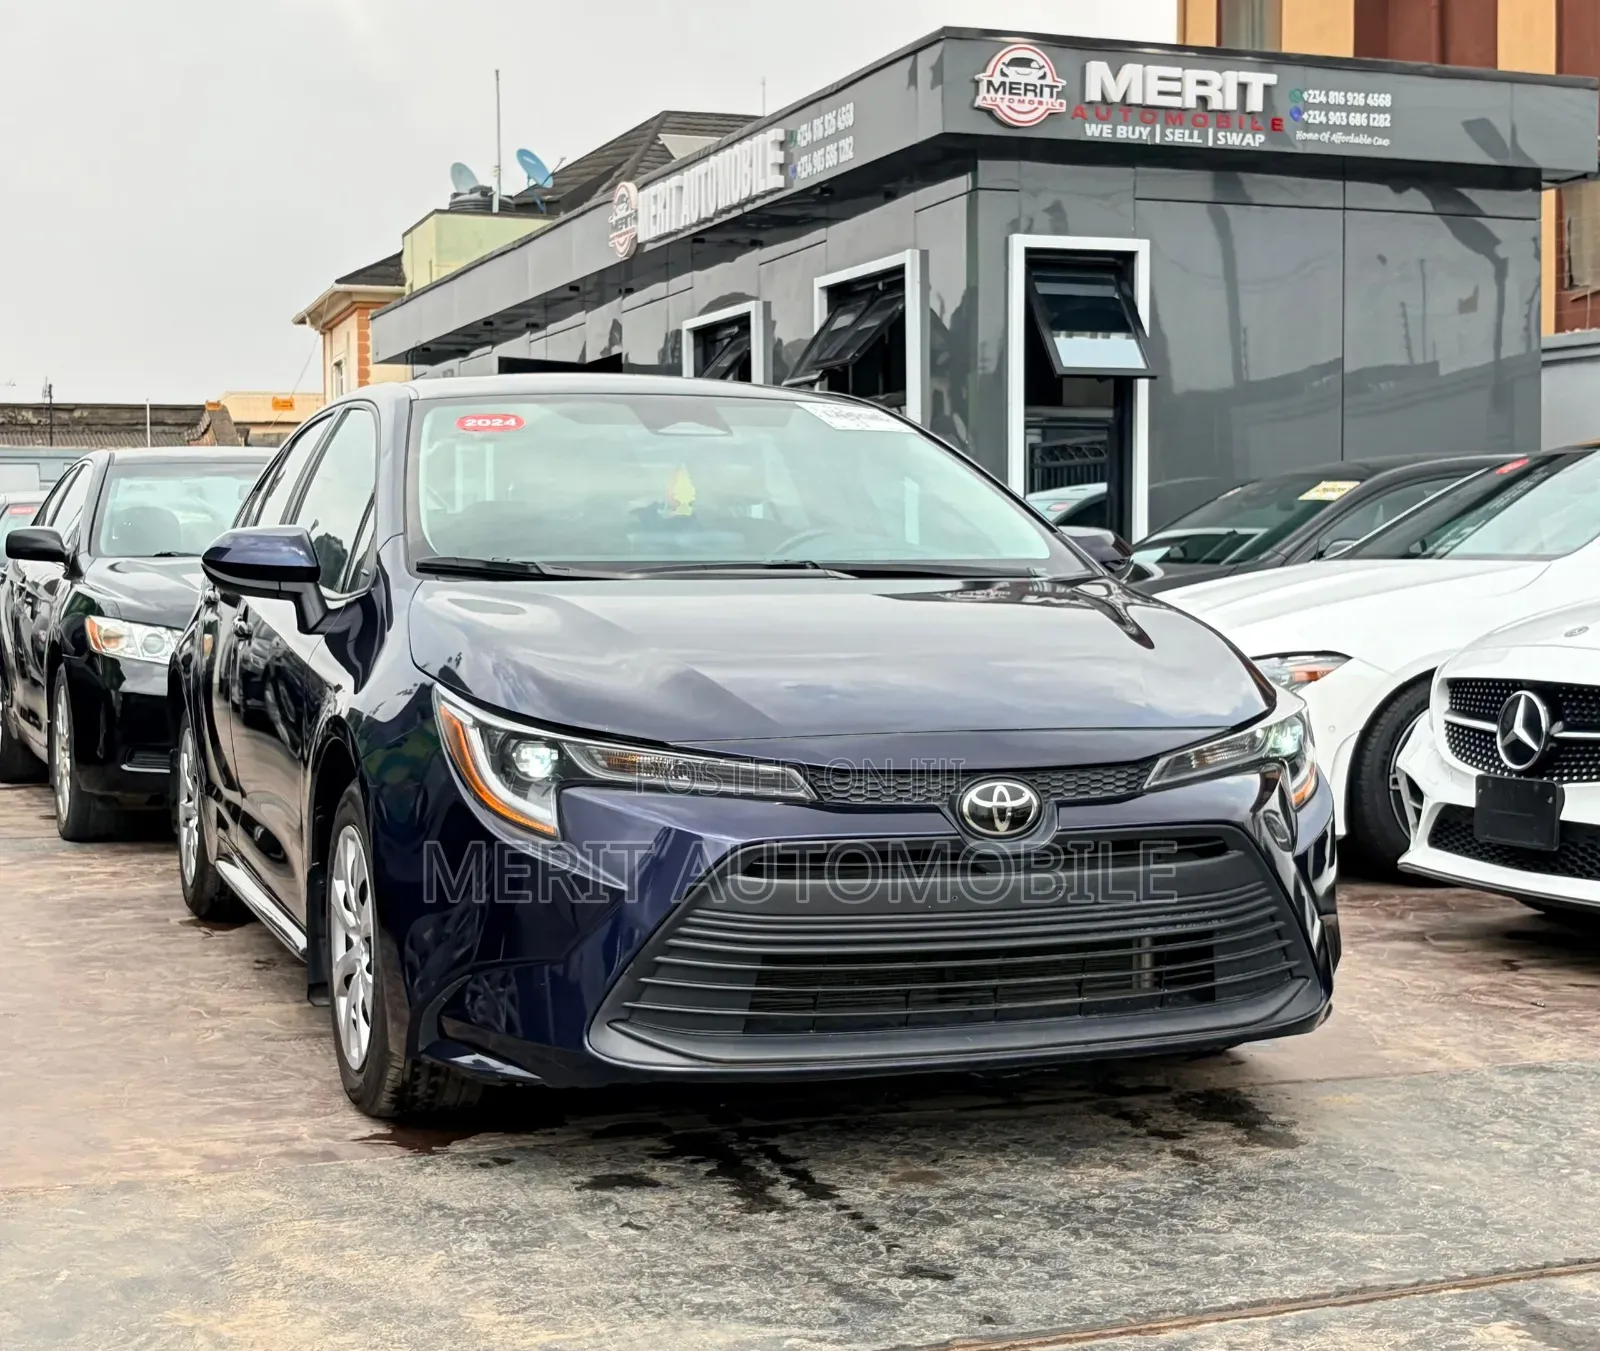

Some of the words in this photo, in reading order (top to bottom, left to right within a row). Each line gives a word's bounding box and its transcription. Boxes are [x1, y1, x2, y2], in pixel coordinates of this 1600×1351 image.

[986, 80, 1059, 98] MERIT
[1085, 61, 1277, 112] MERIT
[981, 95, 1065, 107] AUTOMOBILE
[1303, 89, 1327, 103] +234
[1328, 91, 1345, 105] 816
[1347, 92, 1365, 106] 926
[1071, 104, 1284, 132] AUTOMOBILE
[1302, 110, 1327, 124] +234
[1328, 111, 1347, 125] 903
[1085, 123, 1112, 138] WE
[1116, 125, 1151, 141] BUY
[1164, 128, 1203, 143] SELL
[1217, 131, 1266, 147] SWAP
[681, 128, 785, 228] AUTOMOBILE
[464, 418, 517, 427] 2024
